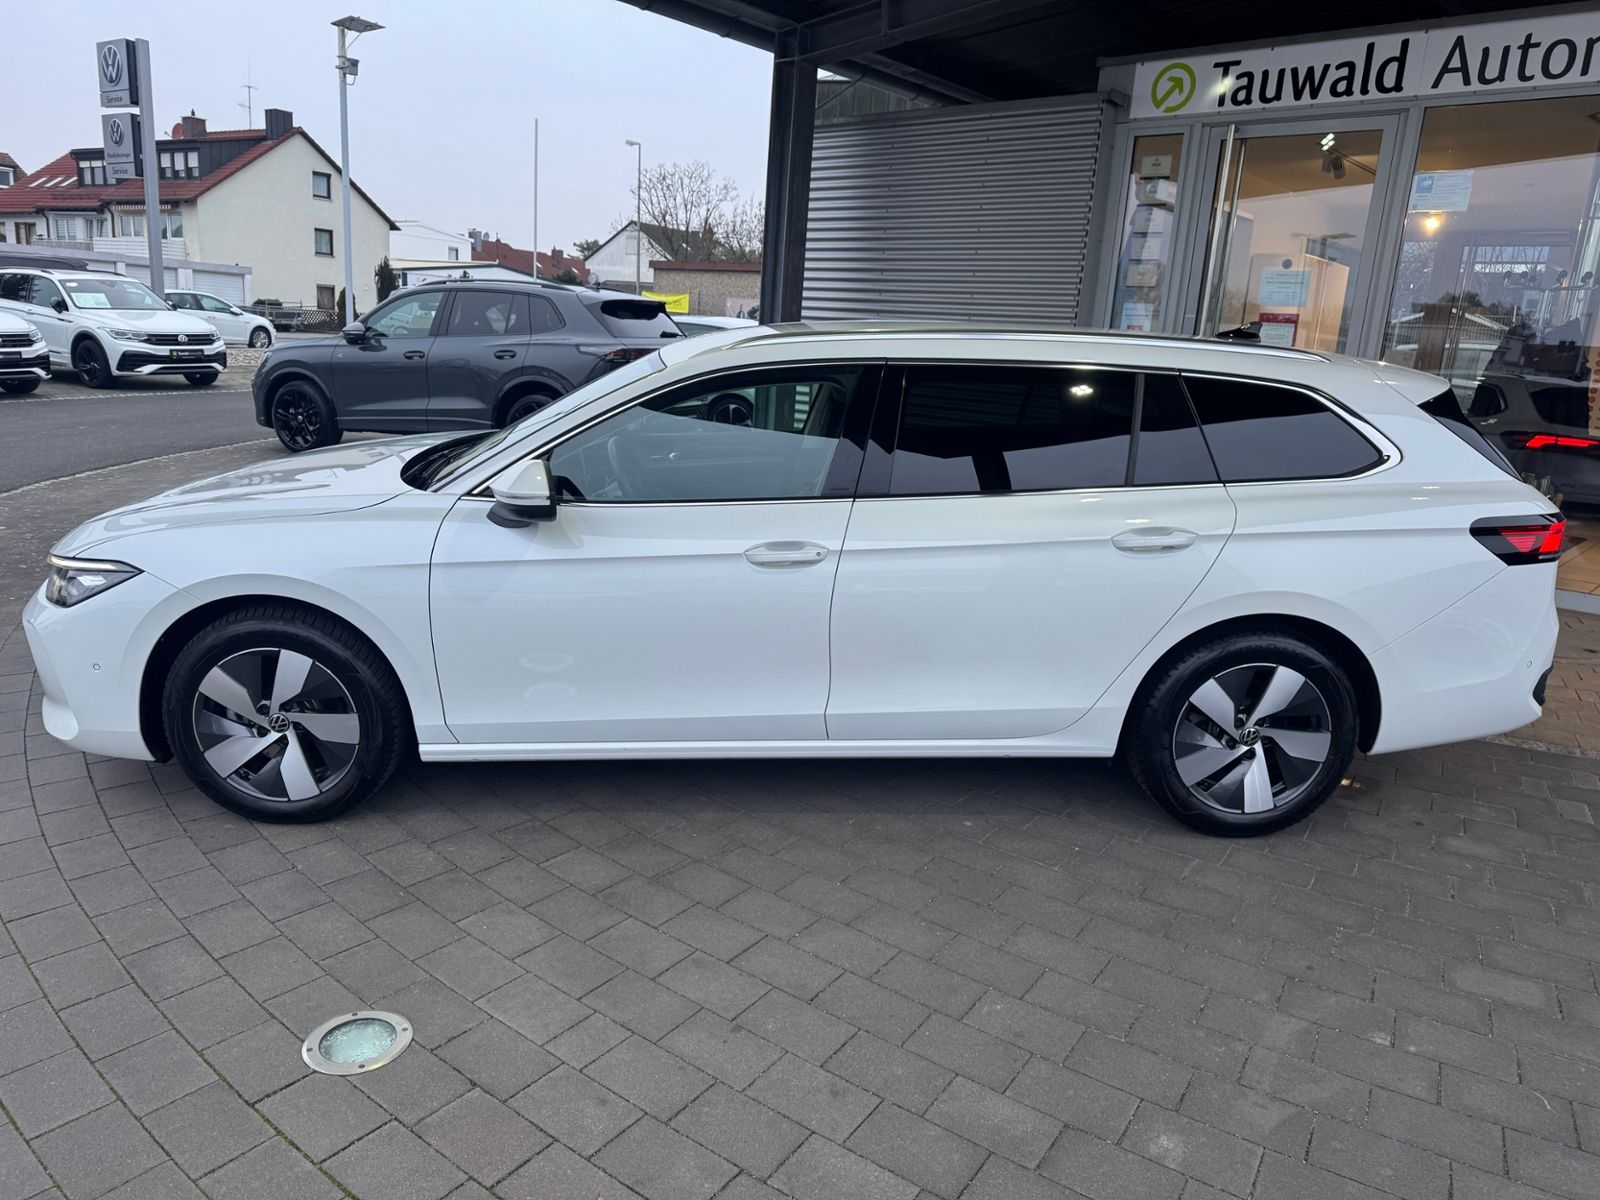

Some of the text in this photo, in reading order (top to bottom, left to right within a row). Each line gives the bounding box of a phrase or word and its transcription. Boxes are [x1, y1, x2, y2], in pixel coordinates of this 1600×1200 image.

[101, 45, 121, 85] VW
[1212, 38, 1410, 107] Tauwald
[270, 714, 289, 731] VW
[1240, 728, 1260, 746] VW
